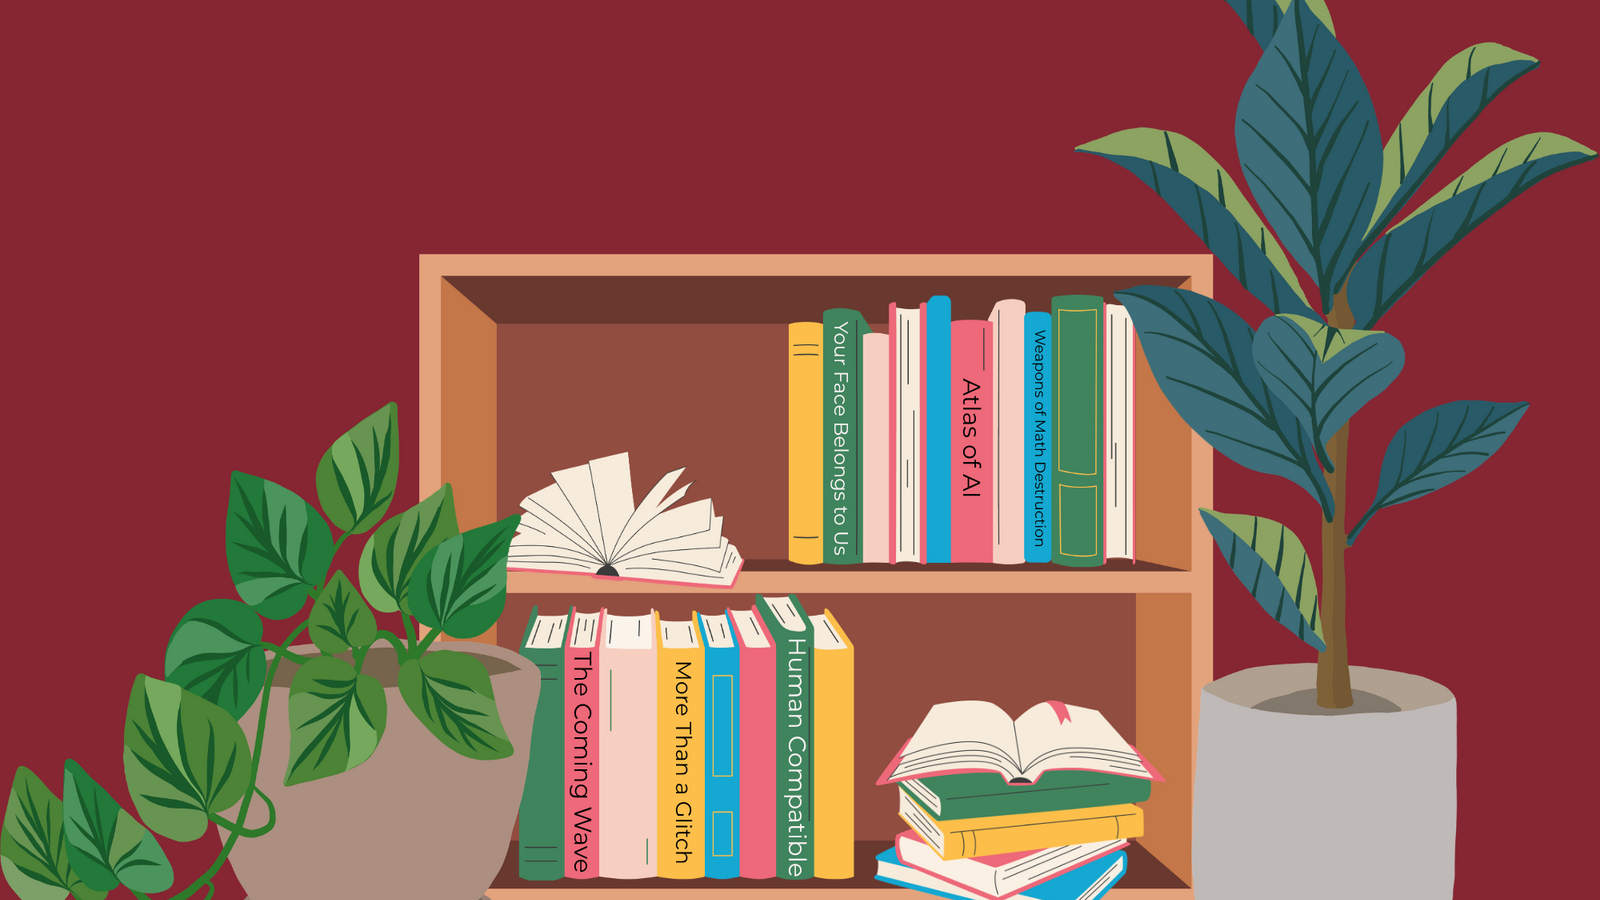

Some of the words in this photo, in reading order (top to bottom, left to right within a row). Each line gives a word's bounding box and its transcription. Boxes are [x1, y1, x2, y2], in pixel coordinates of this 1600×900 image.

[833, 321, 849, 366] Your
[1031, 329, 1046, 398] Weapons
[833, 371, 849, 416] Face
[962, 377, 981, 438] Atlas
[1033, 401, 1047, 417] of
[829, 423, 850, 501] Belongs
[962, 445, 982, 469] of
[1033, 420, 1047, 457] Math
[962, 473, 981, 498] AI
[1033, 462, 1047, 547] Destruction
[833, 505, 848, 526] to
[833, 532, 849, 556] Us
[573, 651, 593, 696] The
[674, 661, 692, 716] More
[788, 639, 807, 728] Human
[568, 703, 593, 798] Coming
[674, 721, 693, 775] Than
[674, 783, 688, 794] a
[782, 736, 808, 877] Compatible
[573, 806, 592, 873] Wave
[674, 801, 693, 864] Glitch
